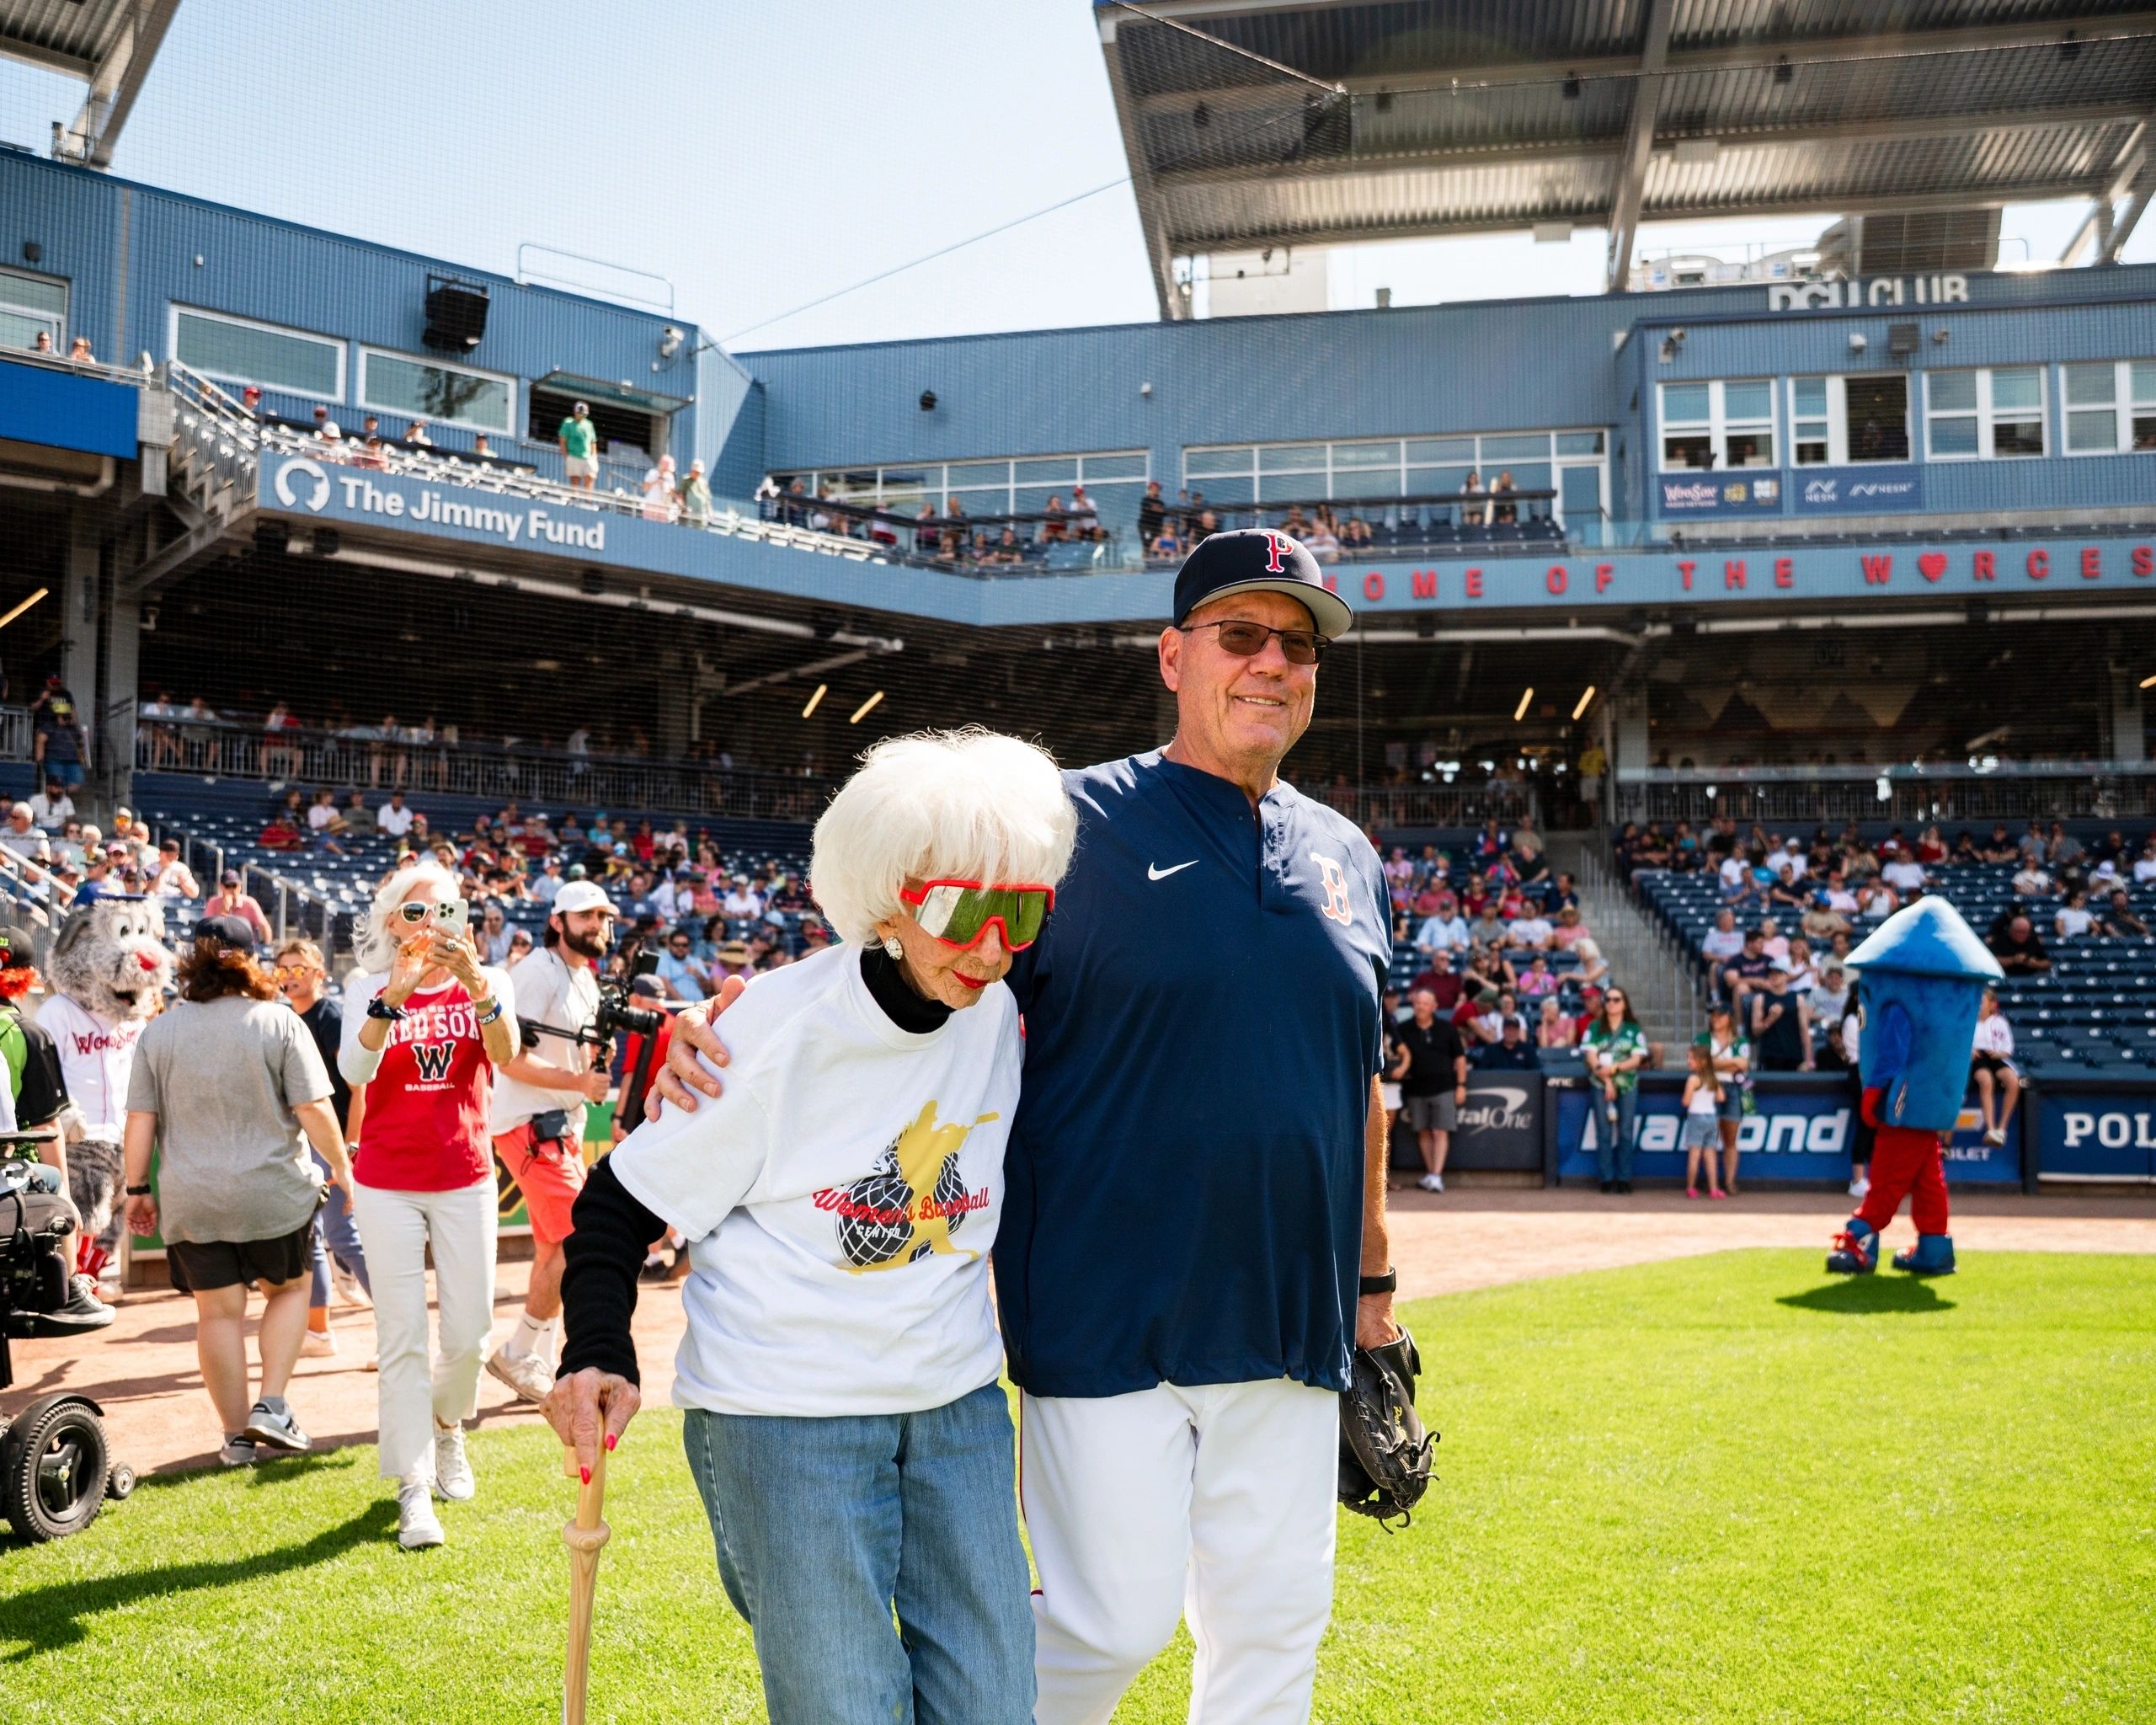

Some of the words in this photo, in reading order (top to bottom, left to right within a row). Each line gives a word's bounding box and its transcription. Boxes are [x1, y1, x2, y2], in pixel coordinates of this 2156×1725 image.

[1869, 275, 1968, 307] CLUB
[339, 477, 404, 516] The
[410, 490, 523, 542] Jimmy
[527, 510, 606, 551] Fund
[1262, 532, 1294, 573] P
[1546, 564, 1614, 594] OF
[1676, 558, 1794, 590] THE
[1310, 852, 1353, 926] B
[434, 1007, 480, 1040] SOX
[411, 1040, 456, 1081] W
[404, 1082, 456, 1092] BASEBALL
[813, 1188, 915, 1225] Women's
[919, 1187, 990, 1220] Baseball
[857, 1225, 900, 1238] CENTER
